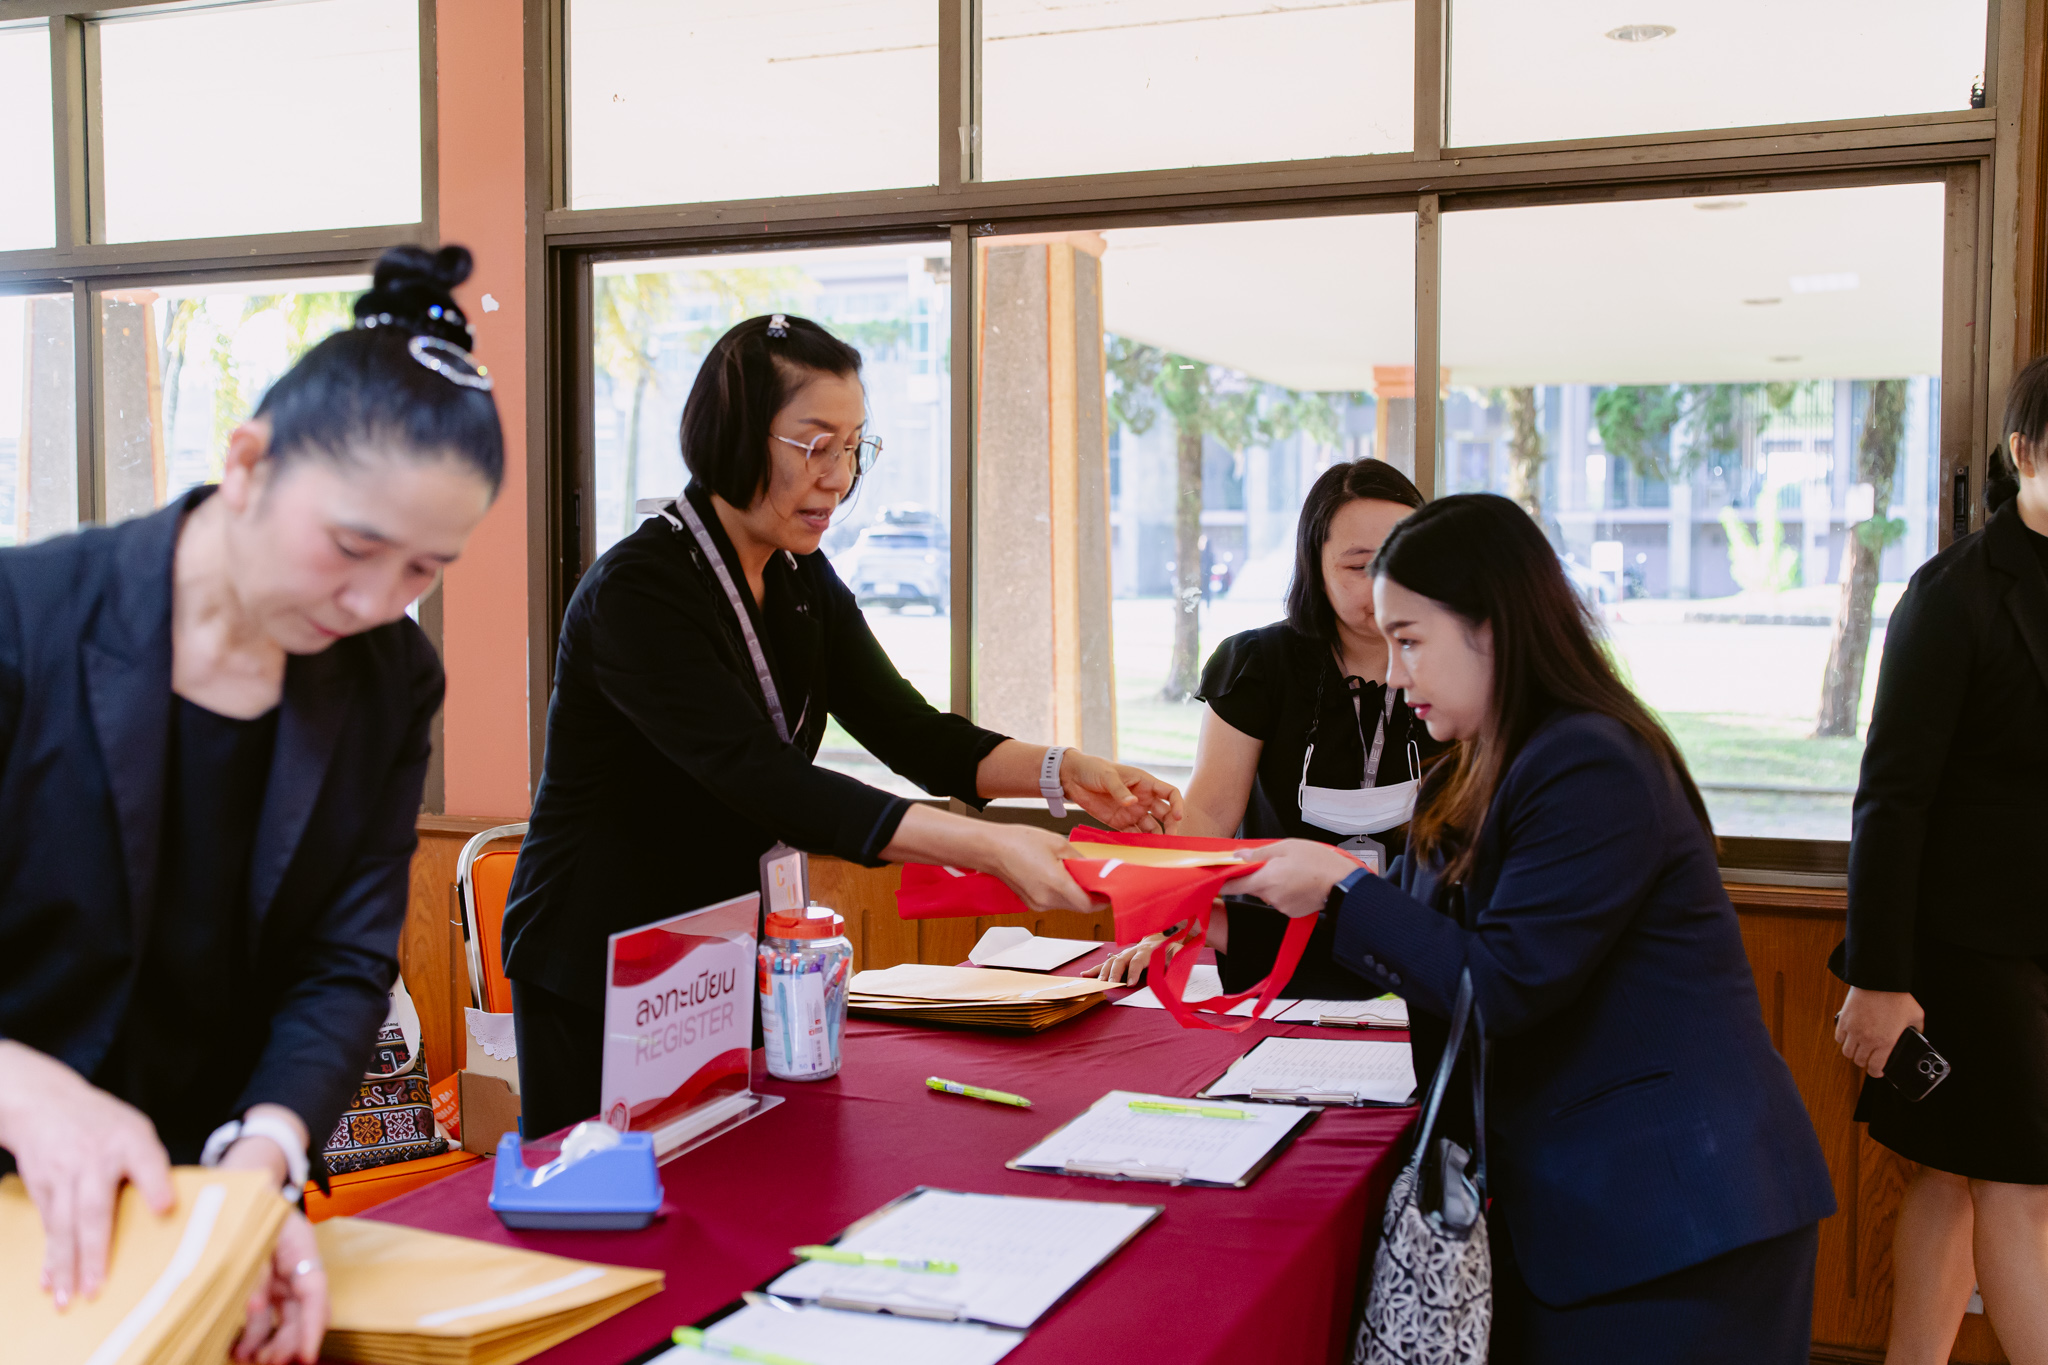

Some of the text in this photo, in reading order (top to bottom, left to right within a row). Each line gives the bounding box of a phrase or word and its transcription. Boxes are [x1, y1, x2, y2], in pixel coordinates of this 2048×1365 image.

[636, 967, 735, 1027] ลงทะเบียน
[635, 1002, 734, 1067] REGISTER
